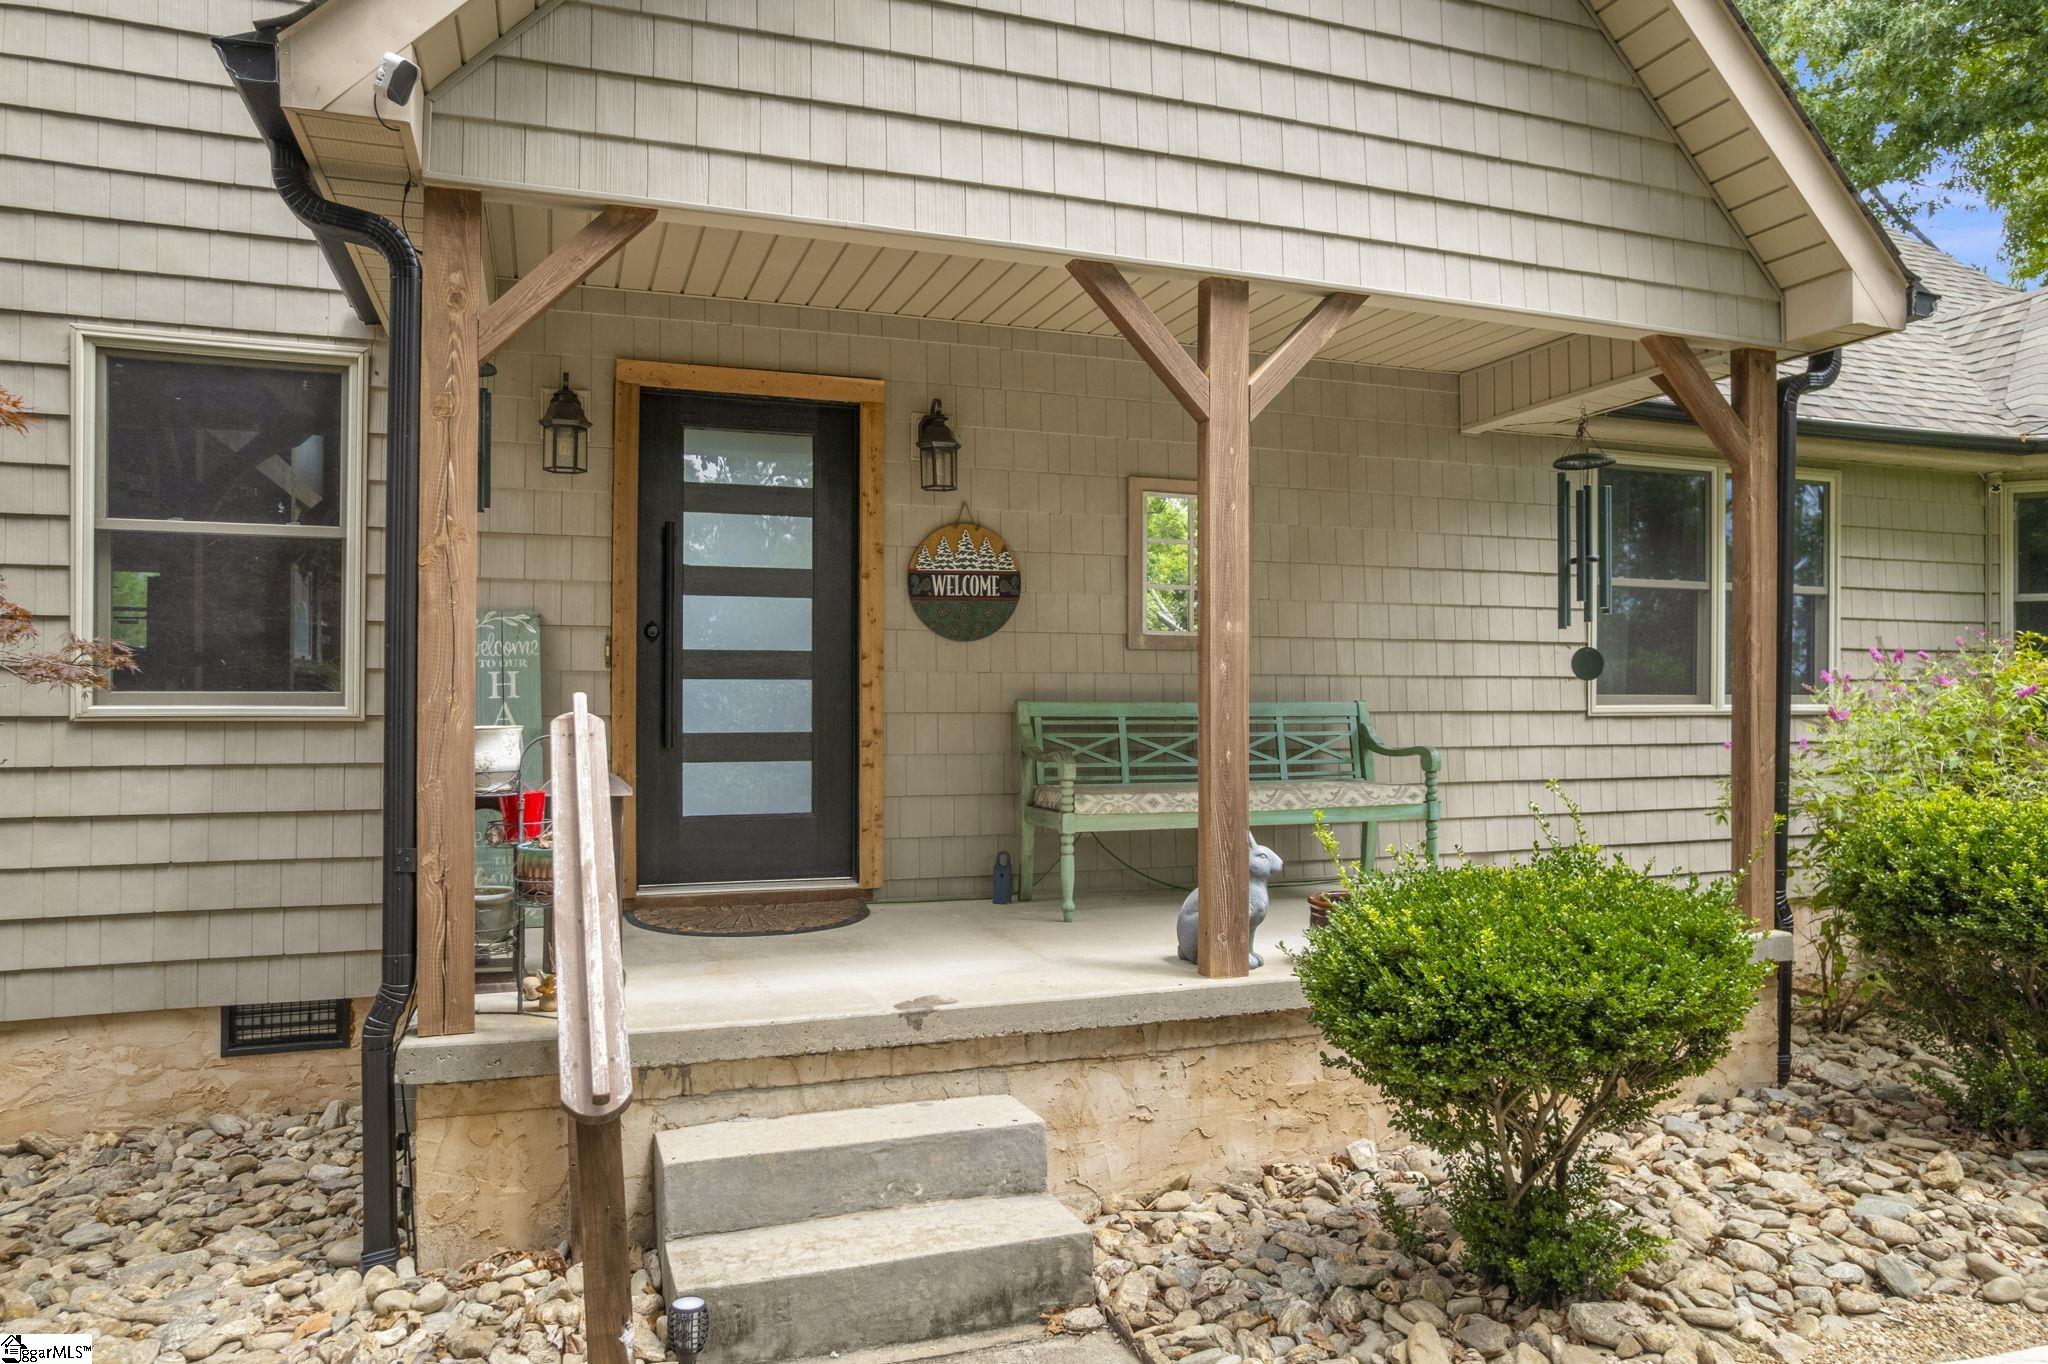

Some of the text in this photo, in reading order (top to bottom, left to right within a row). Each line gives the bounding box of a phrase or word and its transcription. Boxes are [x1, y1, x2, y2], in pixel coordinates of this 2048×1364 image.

[931, 574, 1000, 597] WELCOME
[478, 659, 528, 668] TO OUR
